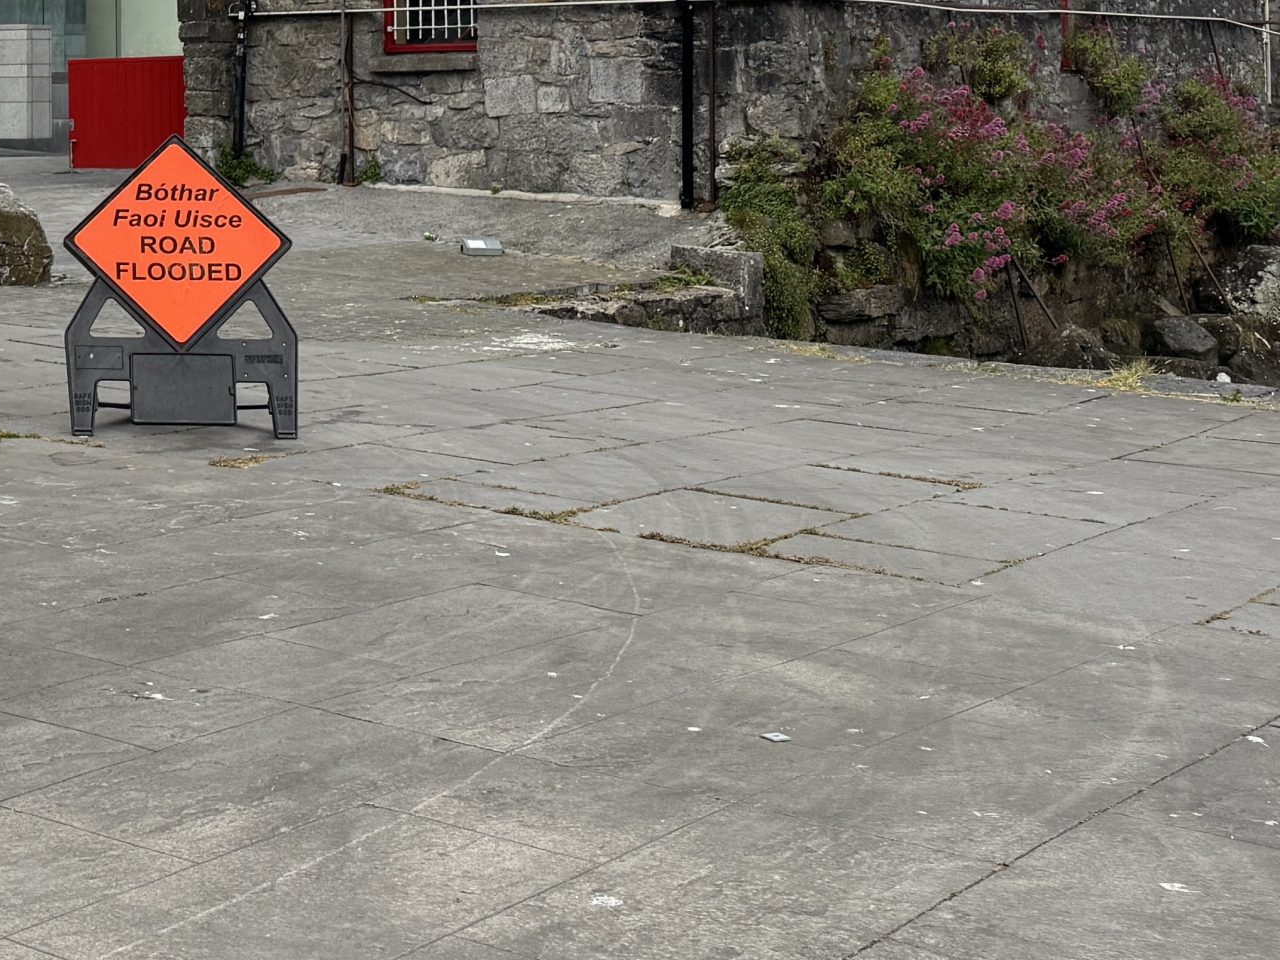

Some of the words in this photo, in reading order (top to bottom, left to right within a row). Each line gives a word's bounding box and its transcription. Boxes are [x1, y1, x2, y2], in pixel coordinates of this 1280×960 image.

[135, 183, 219, 201] Bóthar
[113, 209, 166, 227] Faoi
[174, 210, 242, 228] Uisce
[140, 236, 215, 254] ROAD
[116, 262, 242, 281] FLOODED
